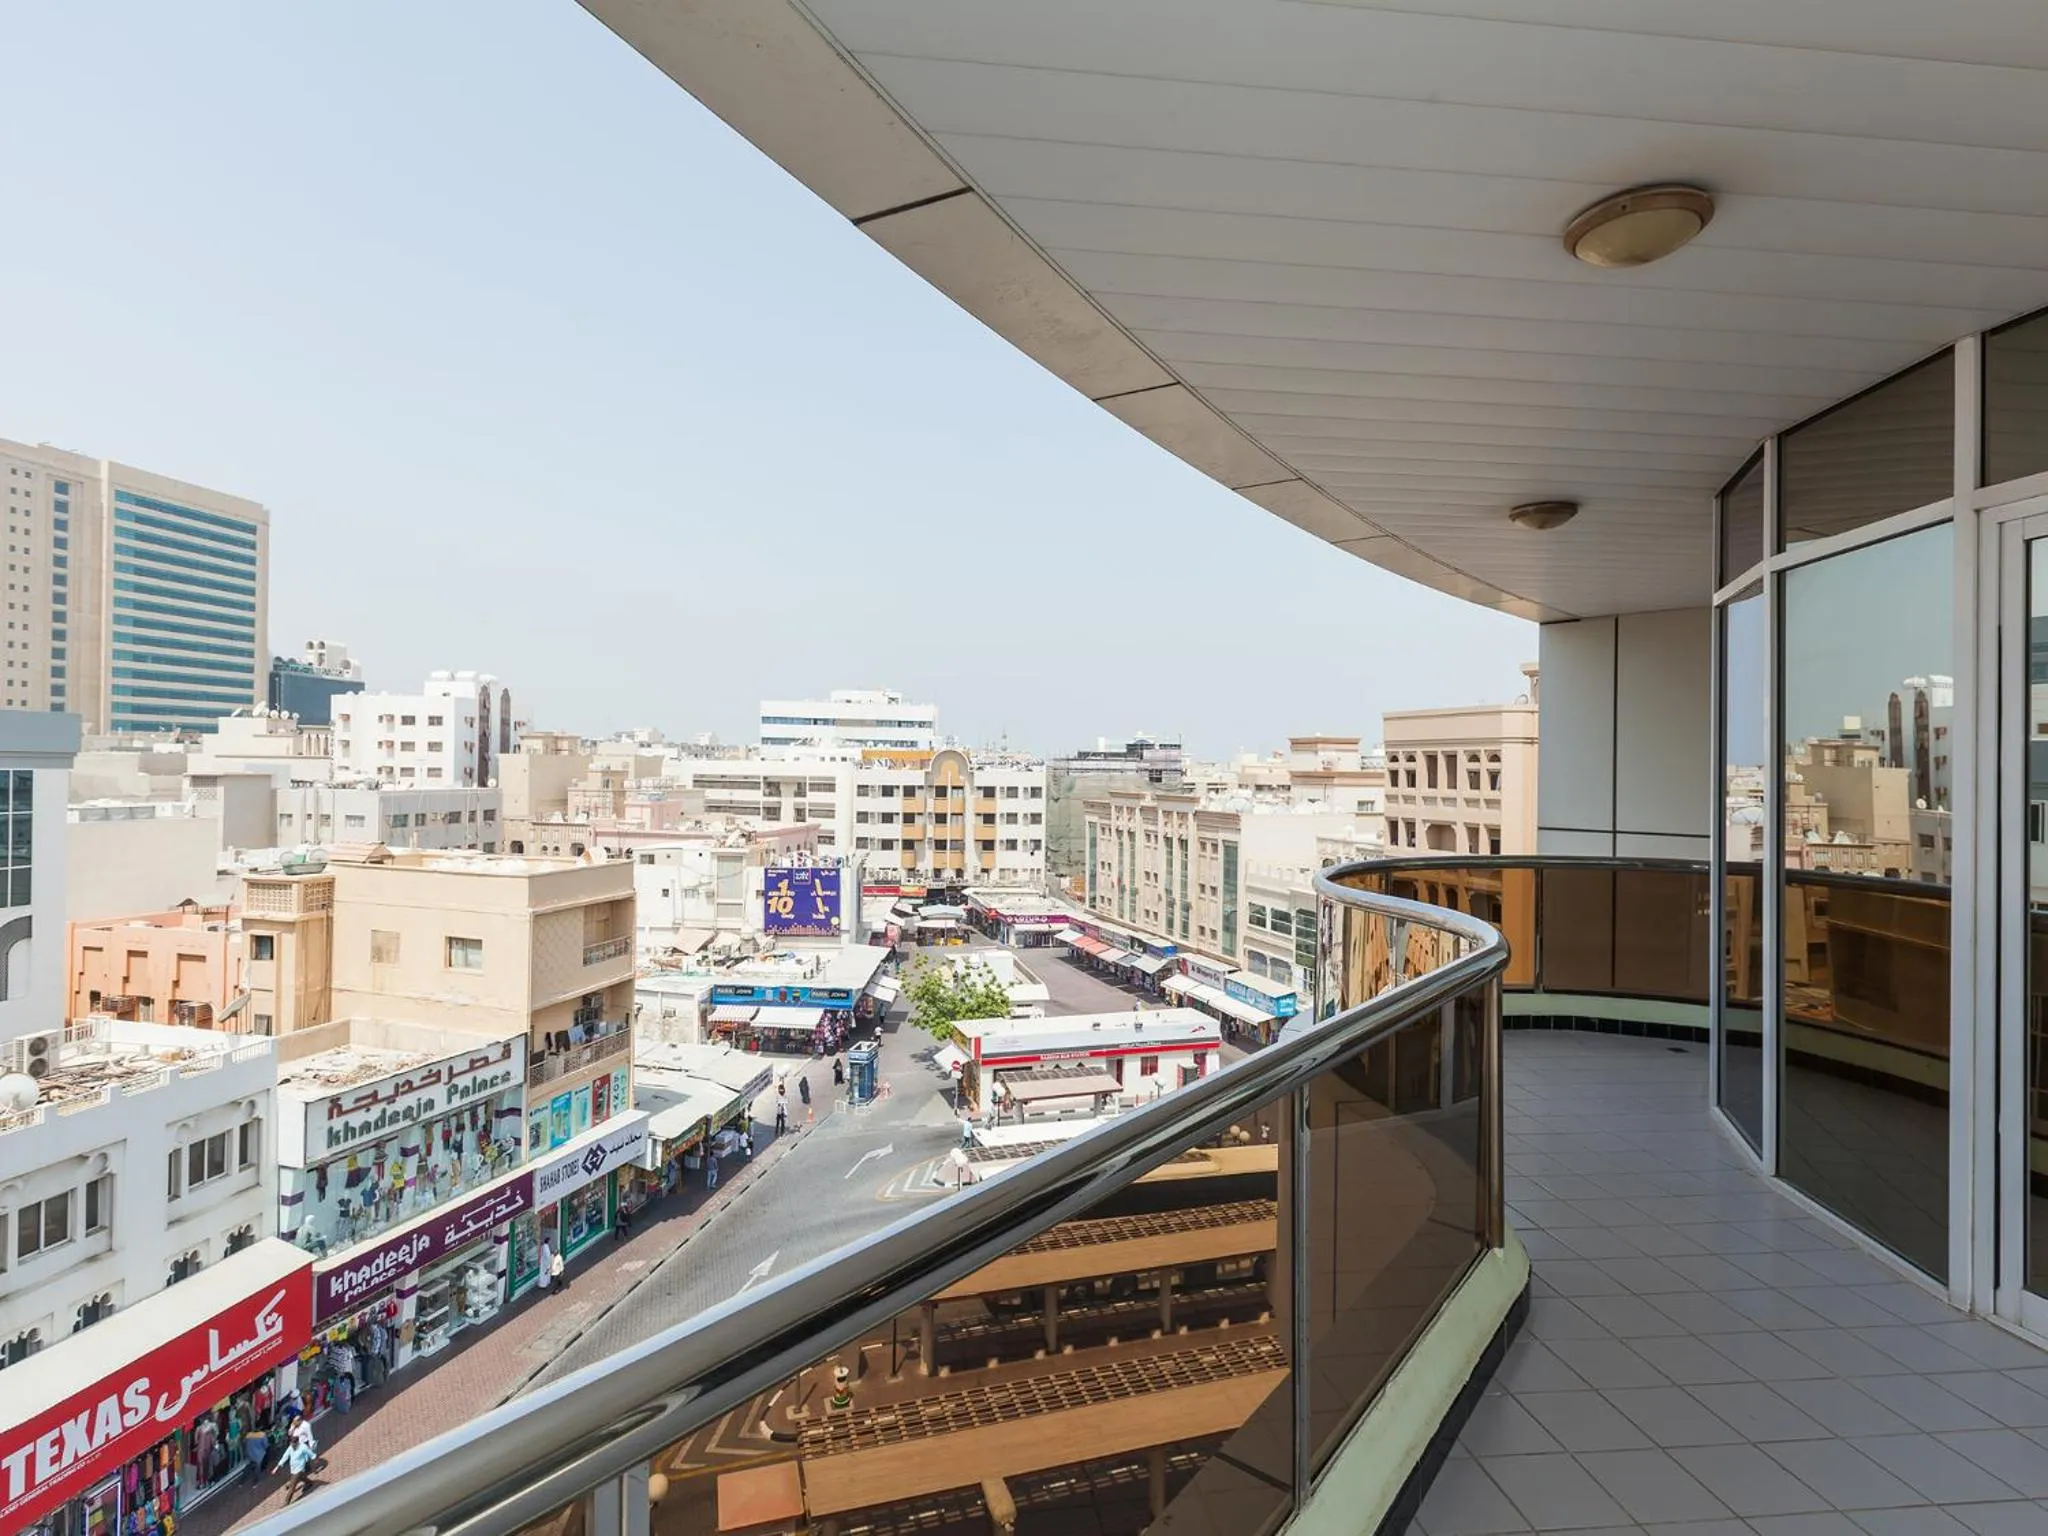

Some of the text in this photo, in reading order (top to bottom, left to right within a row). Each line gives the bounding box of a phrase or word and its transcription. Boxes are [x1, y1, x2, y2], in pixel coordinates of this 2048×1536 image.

[767, 897, 794, 914] 10
[327, 1043, 512, 1120] قصر خديجة
[445, 1190, 524, 1245] خديجة
[461, 1187, 511, 1222] قصر
[154, 1289, 286, 1422] تكساس
[1, 1377, 151, 1501] TEXAS
